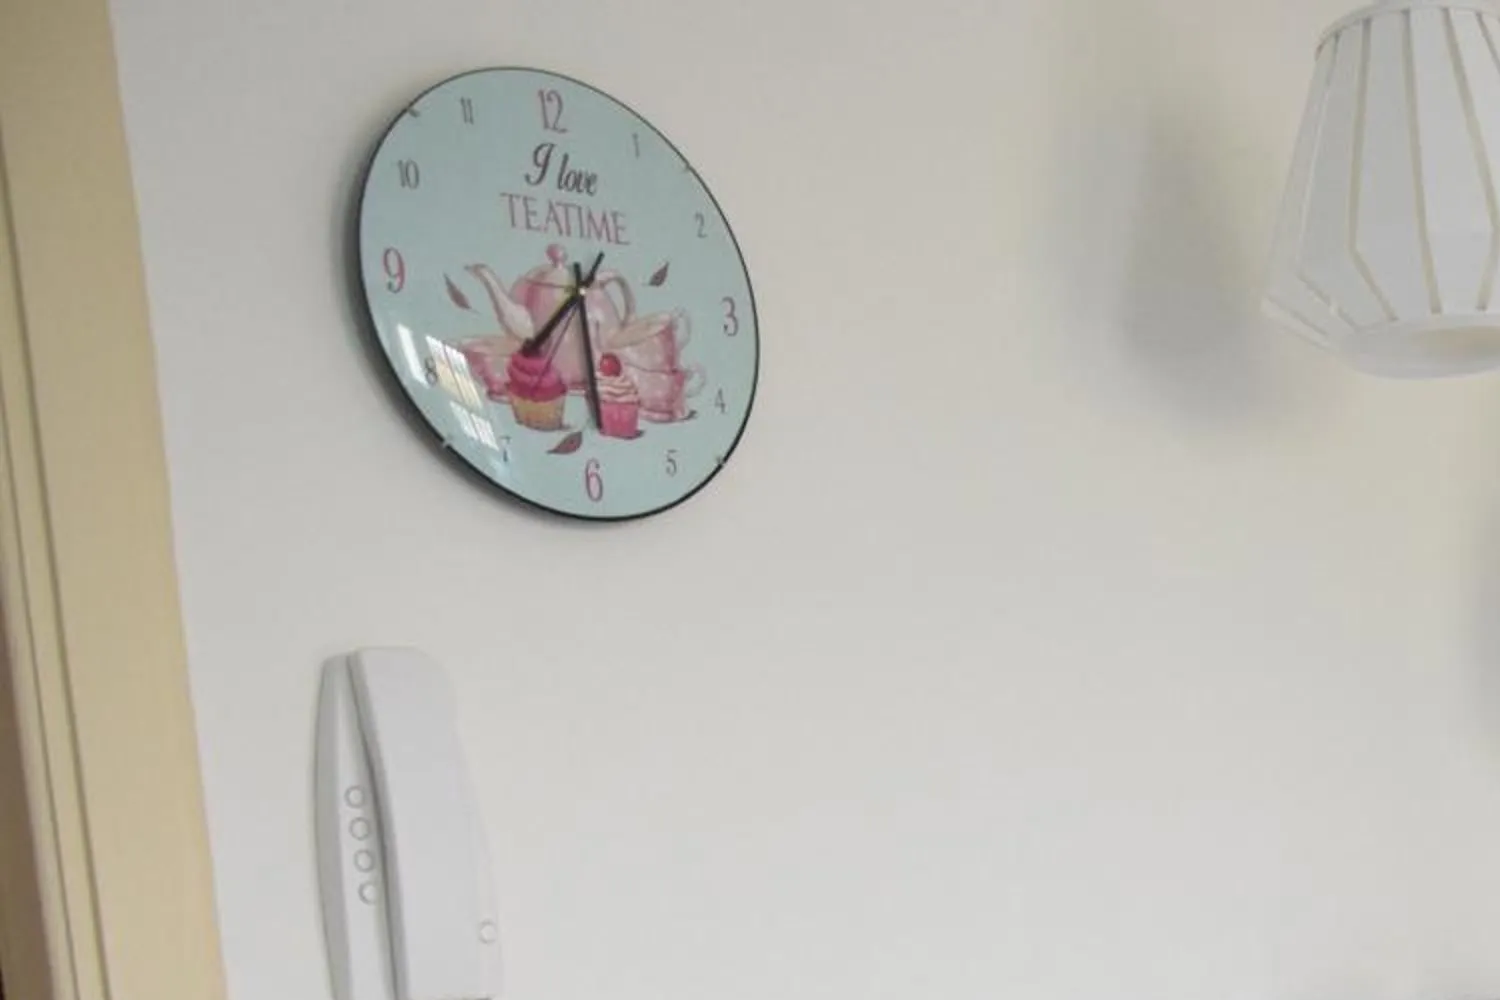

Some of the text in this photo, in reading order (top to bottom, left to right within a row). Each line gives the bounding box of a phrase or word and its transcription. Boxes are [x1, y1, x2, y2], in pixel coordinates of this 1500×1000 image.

[460, 98, 475, 124] 11
[537, 89, 568, 134] 12
[632, 132, 640, 160] 1
[399, 160, 420, 189] 10
[556, 152, 598, 197] love
[500, 192, 631, 246] TEATIME
[695, 213, 707, 238] 2
[383, 248, 406, 293] 9
[722, 297, 739, 337] 3
[424, 356, 438, 388] 8
[714, 388, 727, 414] 4
[667, 449, 678, 476] 5
[585, 458, 604, 502] 6
